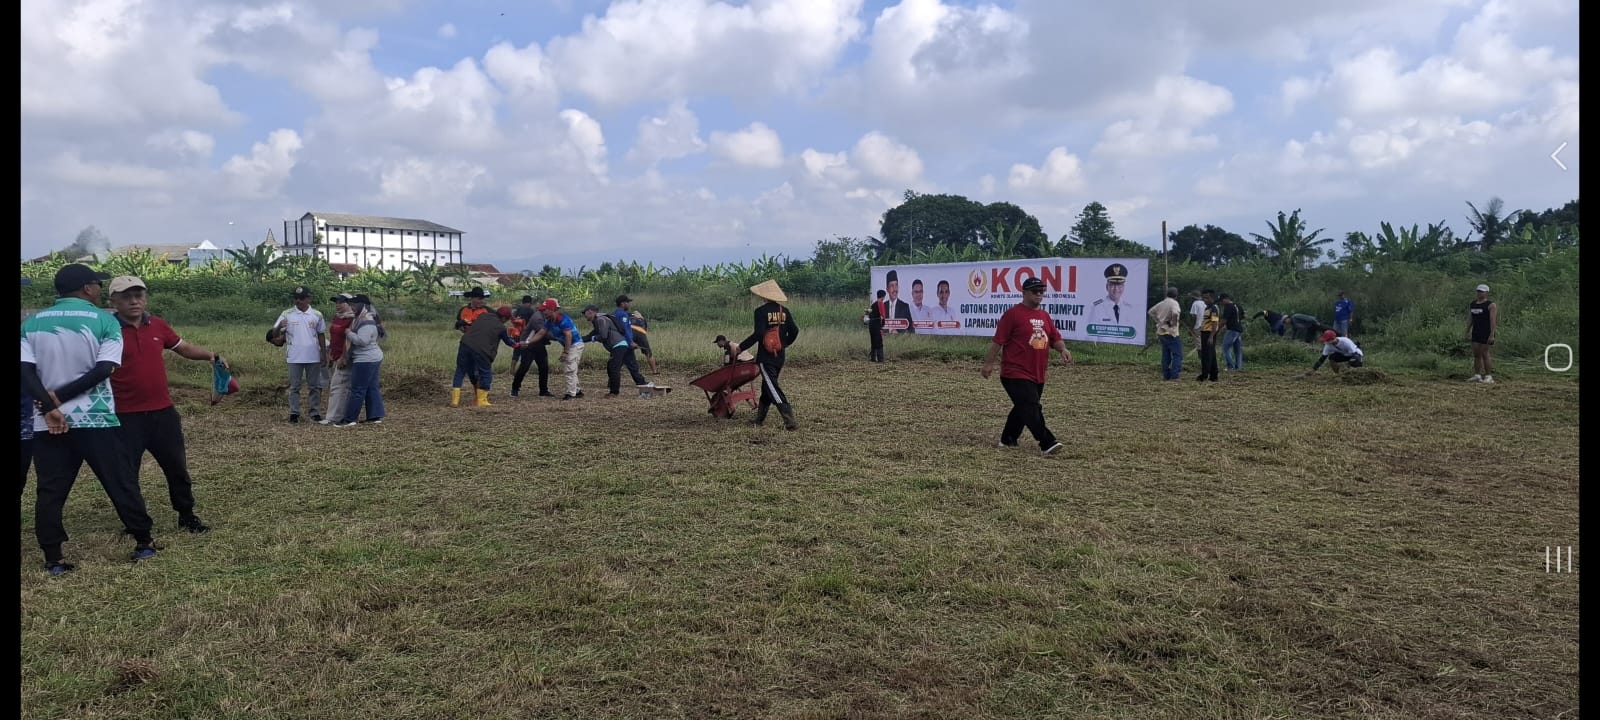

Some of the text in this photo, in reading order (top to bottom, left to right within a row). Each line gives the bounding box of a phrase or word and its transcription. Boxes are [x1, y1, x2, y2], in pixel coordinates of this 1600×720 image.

[991, 265, 1076, 292] KONI
[960, 303, 988, 314] GOTONG
[1048, 303, 1085, 316] RUMPUT
[964, 317, 1000, 329] LAPANGAN
[1054, 320, 1076, 331] ALIKI
